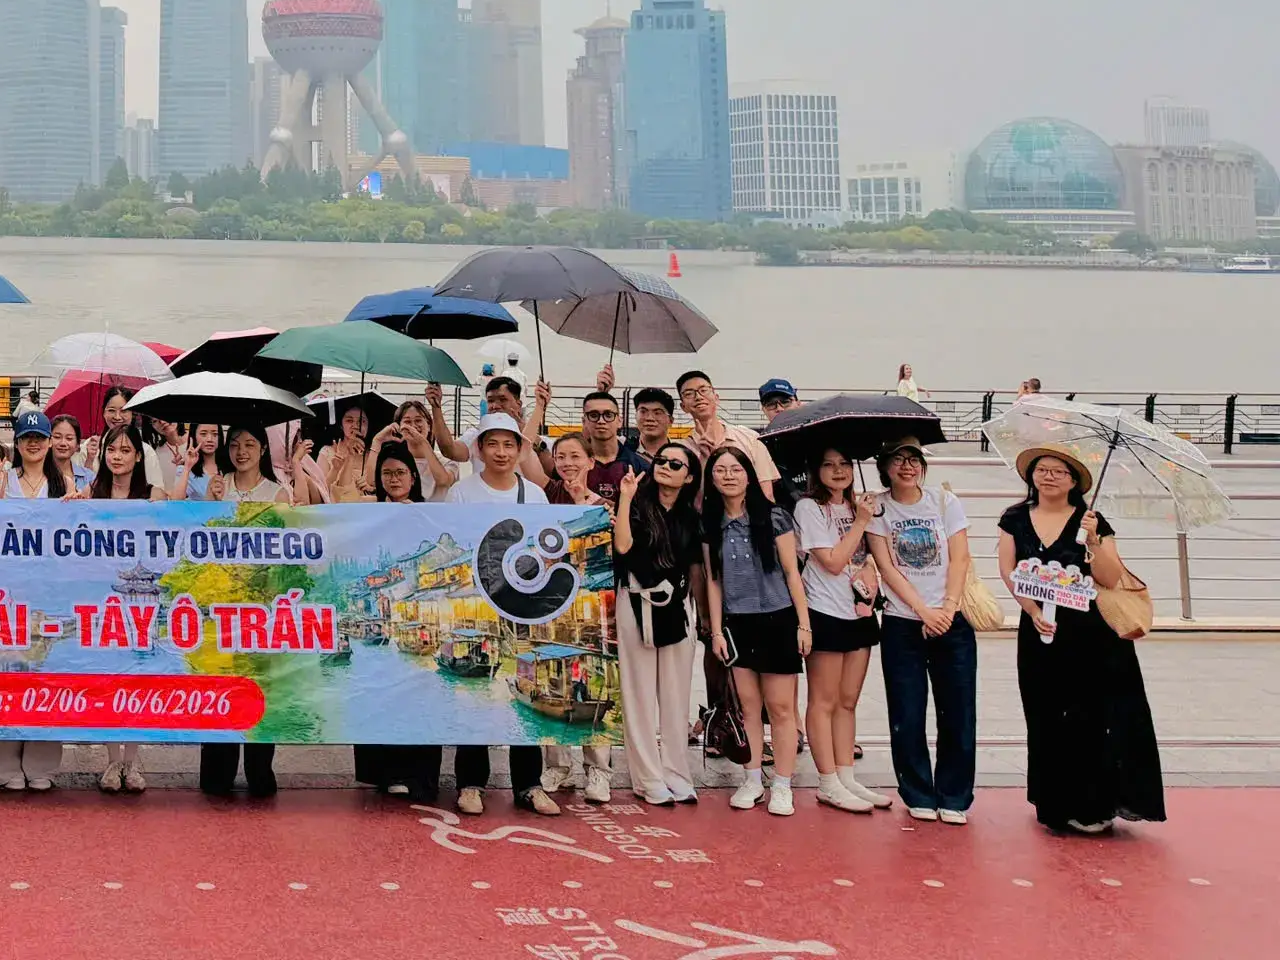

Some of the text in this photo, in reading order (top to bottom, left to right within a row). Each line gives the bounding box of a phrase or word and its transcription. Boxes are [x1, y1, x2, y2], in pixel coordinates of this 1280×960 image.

[53, 523, 135, 558] CÔNG
[145, 529, 180, 558] TY
[190, 530, 324, 560] OWNEGO
[73, 595, 156, 648] TÂY
[170, 596, 199, 649] Ô
[213, 591, 334, 650] TRẤN
[21, 687, 87, 714] 02/06
[112, 688, 232, 716] 06/6/2026
[566, 803, 664, 863] JOGGING
